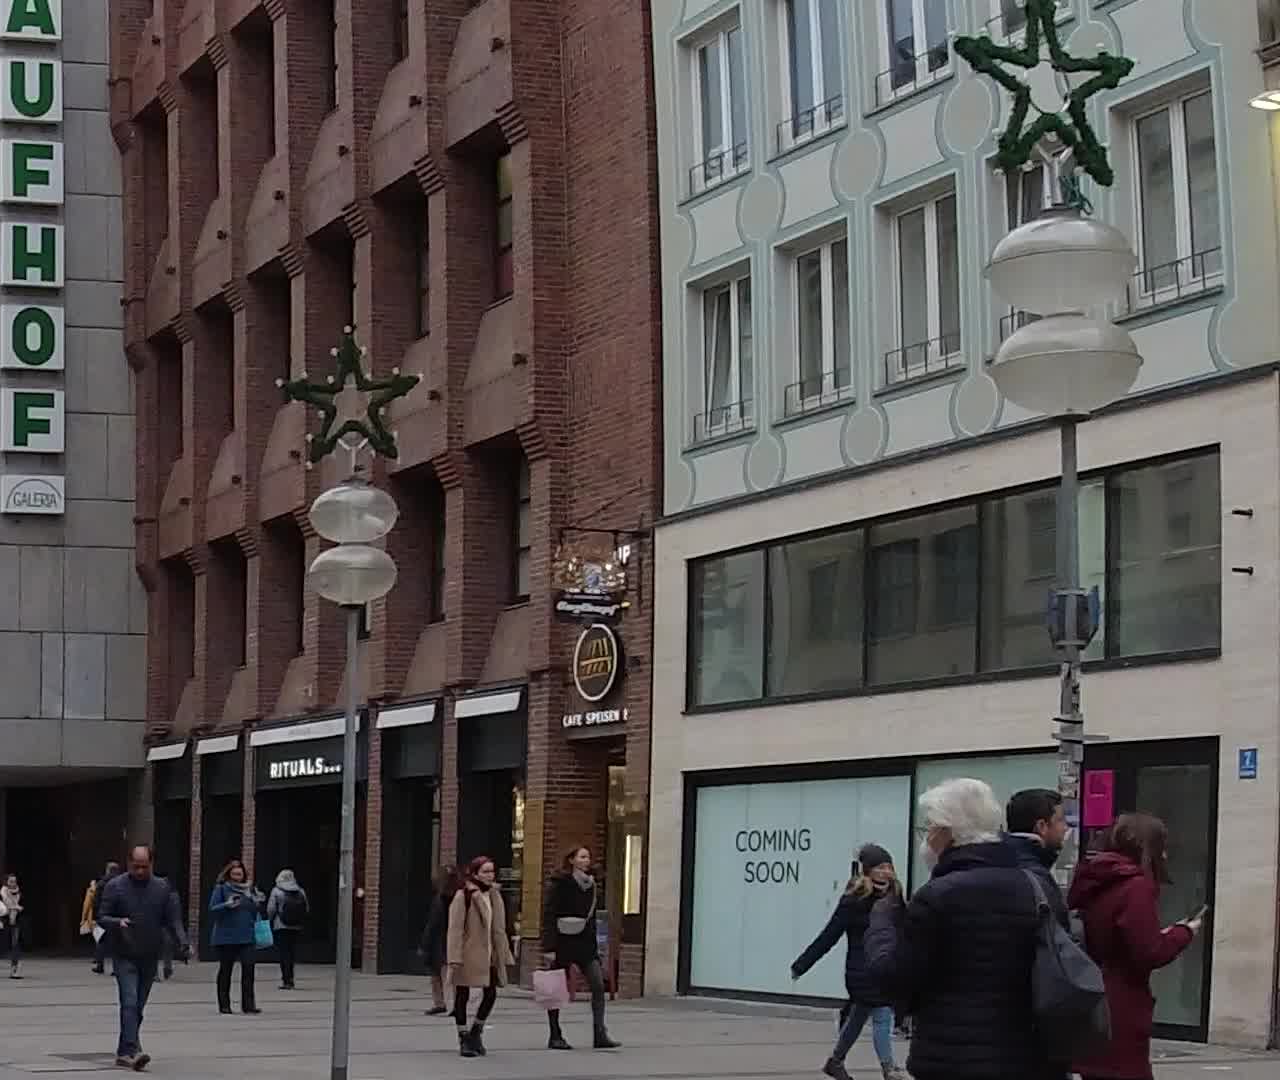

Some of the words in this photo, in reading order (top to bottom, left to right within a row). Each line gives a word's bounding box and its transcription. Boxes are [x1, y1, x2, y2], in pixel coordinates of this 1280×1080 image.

[12, 492, 58, 507] GALERIA
[735, 829, 812, 853] COMING
[743, 860, 800, 885] SOON
